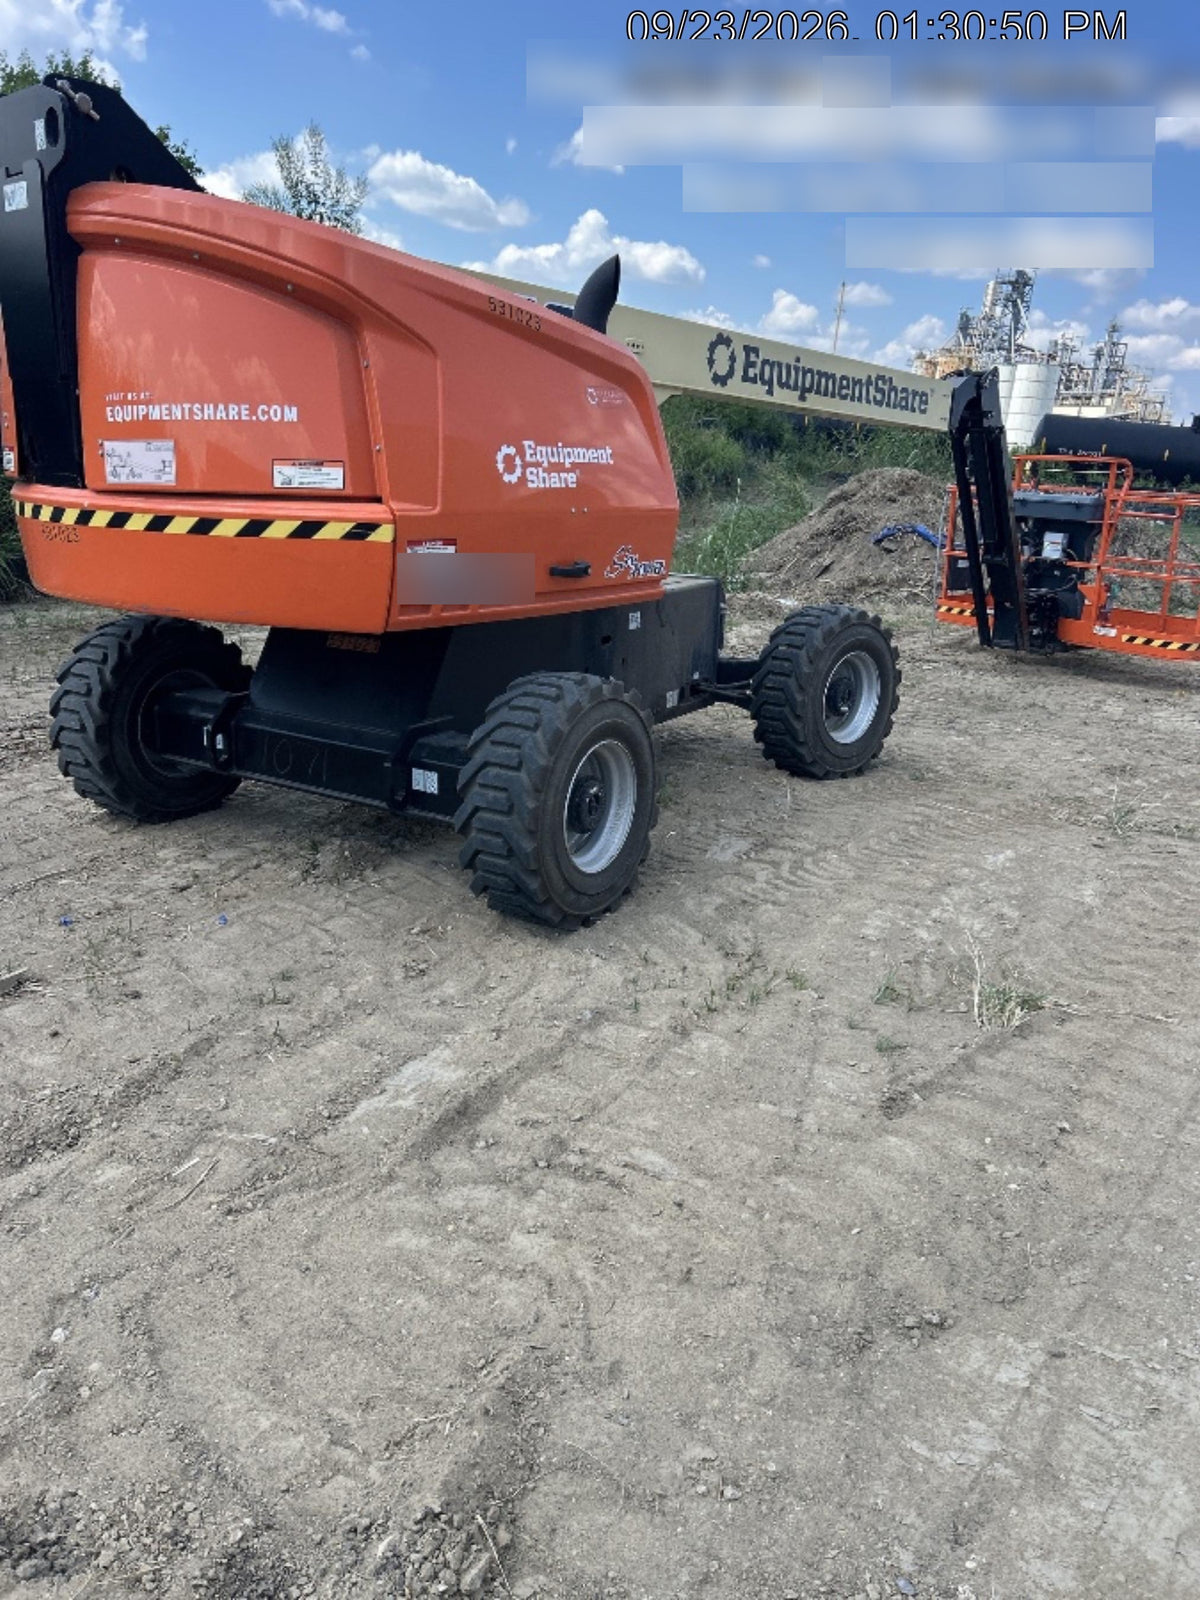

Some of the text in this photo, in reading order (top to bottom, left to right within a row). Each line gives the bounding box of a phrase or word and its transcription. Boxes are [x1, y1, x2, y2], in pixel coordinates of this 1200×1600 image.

[742, 344, 929, 415] EquipmentShare
[106, 403, 298, 423] EQUIPMENTSHARE.COM
[522, 440, 614, 468] Equipment
[526, 467, 578, 488] Share
